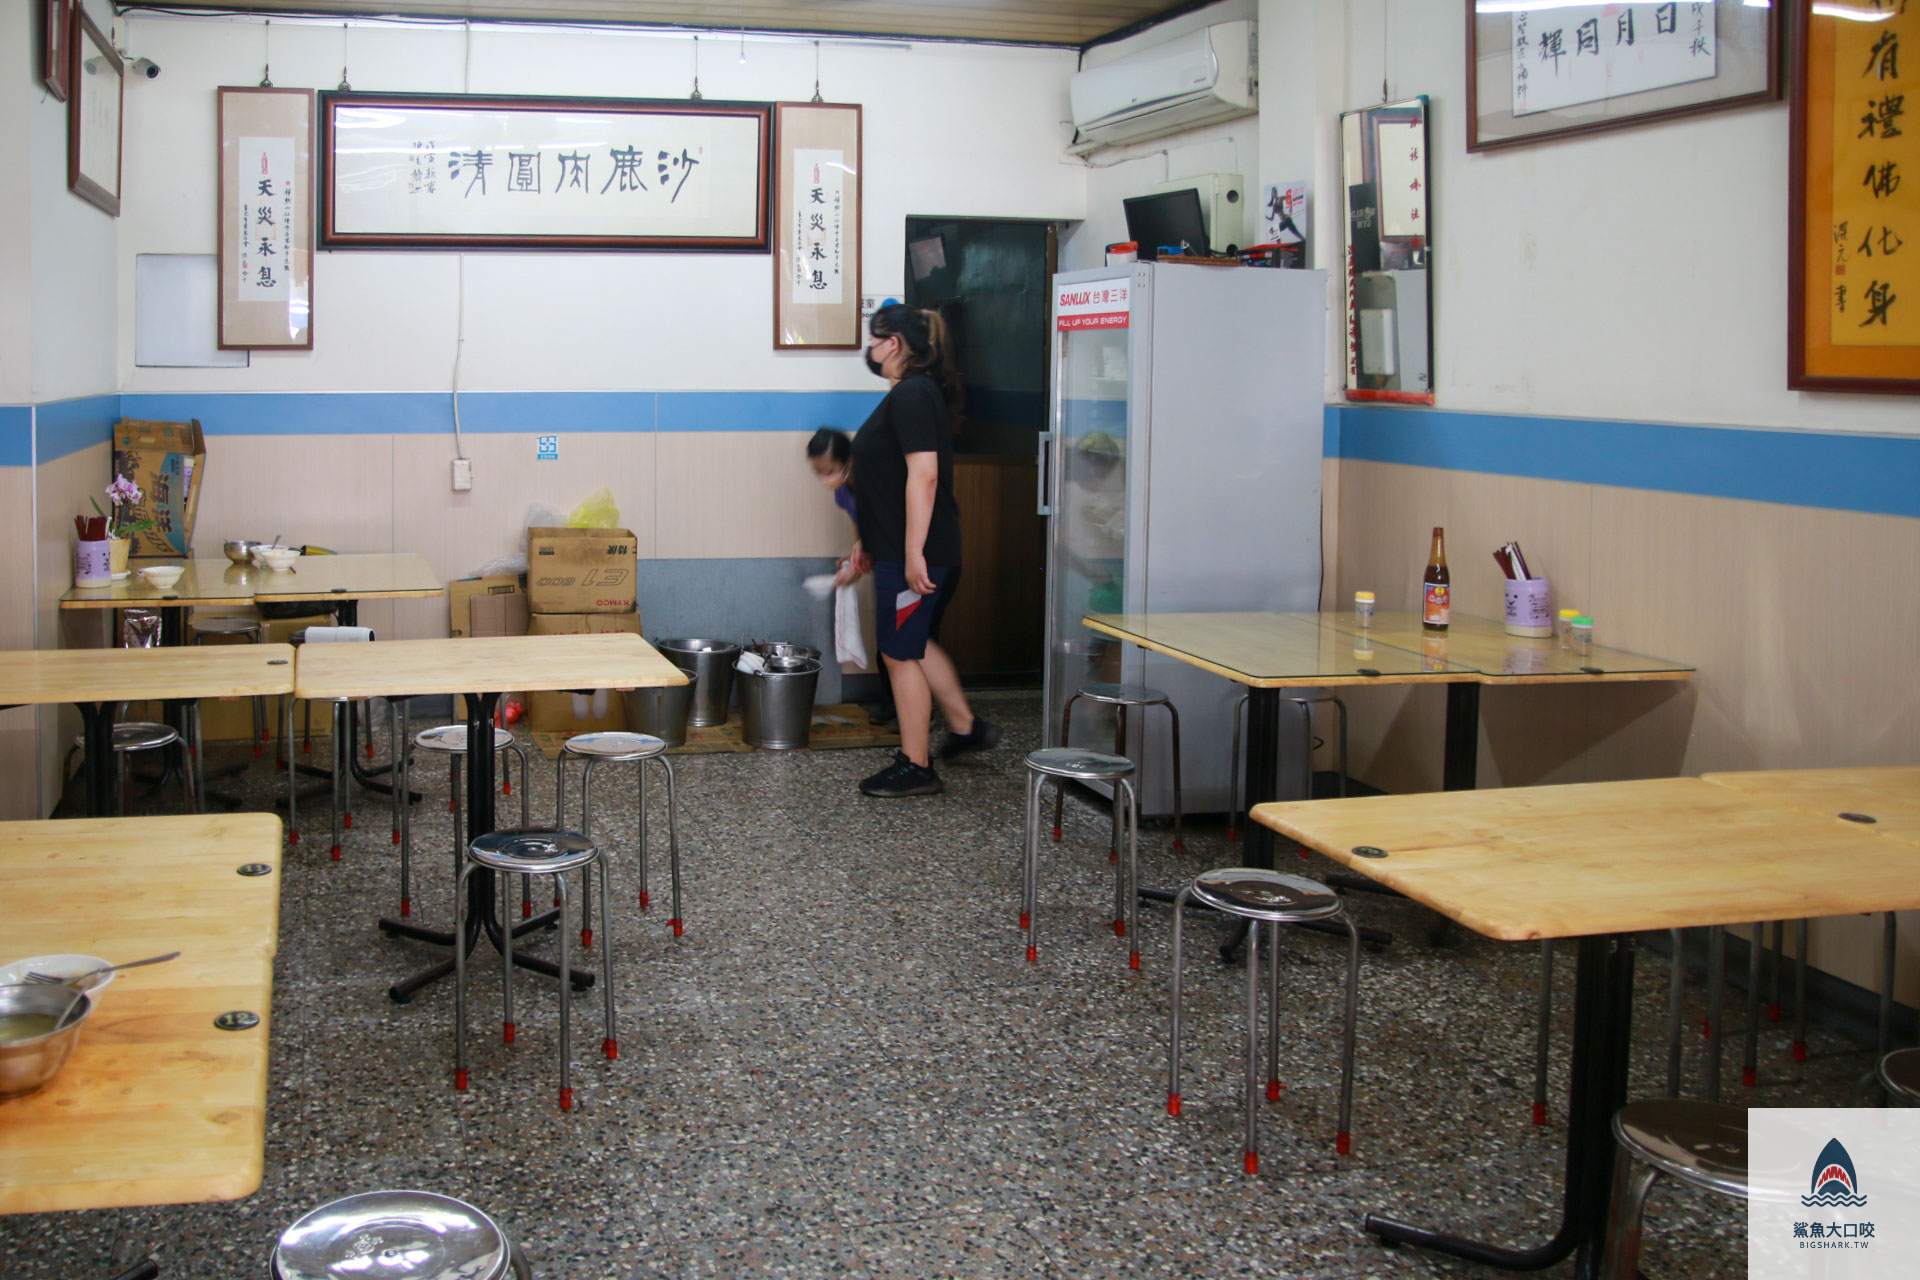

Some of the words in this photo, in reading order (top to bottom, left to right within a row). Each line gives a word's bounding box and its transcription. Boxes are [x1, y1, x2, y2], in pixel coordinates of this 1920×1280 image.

[256, 179, 277, 288] 天災永息
[809, 187, 828, 290] 天災永息
[1060, 291, 1091, 307] SANLUX
[1072, 318, 1081, 326] UP
[1081, 317, 1099, 326] YOUR
[1099, 316, 1127, 325] ENERGY
[224, 1013, 249, 1026] 12
